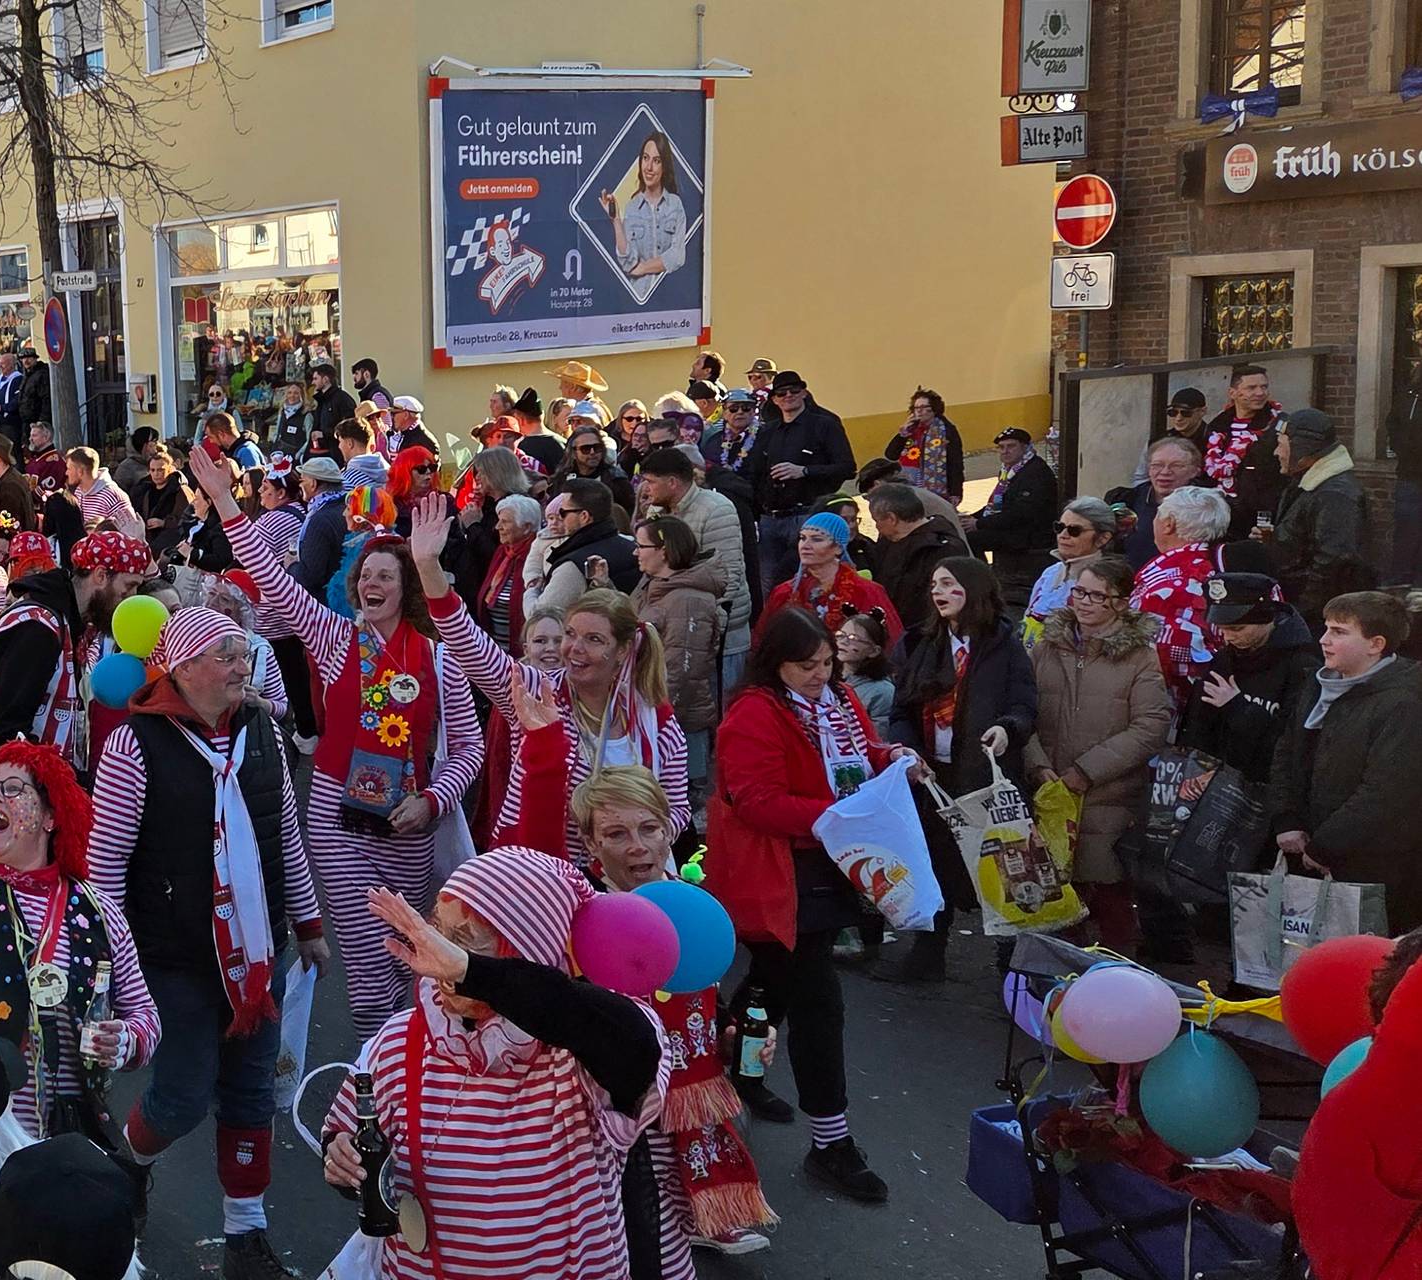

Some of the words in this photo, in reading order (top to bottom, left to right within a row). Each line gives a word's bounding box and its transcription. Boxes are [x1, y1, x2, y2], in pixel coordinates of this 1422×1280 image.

[1024, 40, 1084, 66] Kreuzauer
[1044, 59, 1067, 76] Pils
[458, 114, 492, 137] Gut
[496, 115, 561, 142] gelaunt
[564, 121, 597, 136] zum
[1022, 127, 1051, 149] Alte
[458, 144, 583, 166] Führerschein!
[1272, 141, 1341, 179] früh
[467, 184, 490, 194] Jetzt
[490, 183, 533, 194] anmelden
[56, 274, 92, 286] Poststraße
[550, 287, 558, 297] in
[559, 287, 570, 297] 70
[570, 287, 594, 296] Meter
[1071, 289, 1089, 302] frei
[583, 298, 593, 307] 28
[611, 319, 691, 334] eikes-fahrschule.de
[453, 333, 507, 347] Hauptstraße
[524, 328, 558, 340] Kreuzau
[990, 805, 1021, 824] LIEBE
